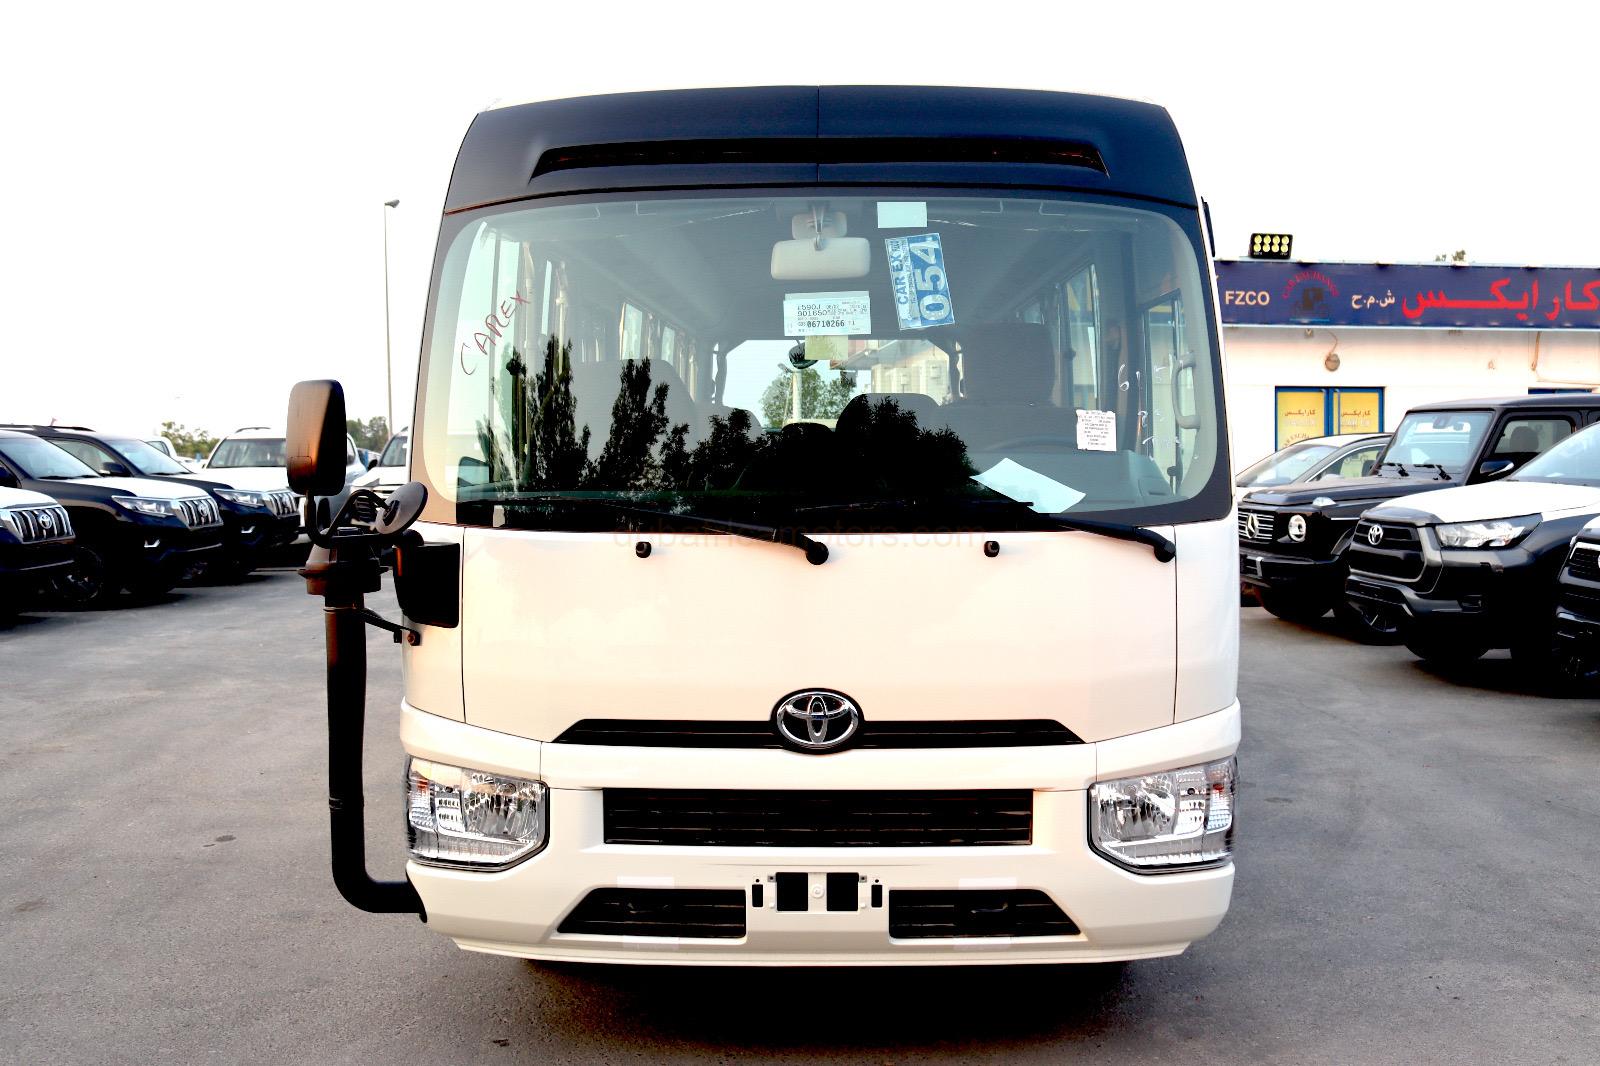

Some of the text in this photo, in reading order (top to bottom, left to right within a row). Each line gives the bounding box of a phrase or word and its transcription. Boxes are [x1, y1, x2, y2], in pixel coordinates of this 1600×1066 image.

[909, 240, 951, 321] 054
[1225, 290, 1270, 305] FZCO
[807, 319, 845, 328] 06710266
